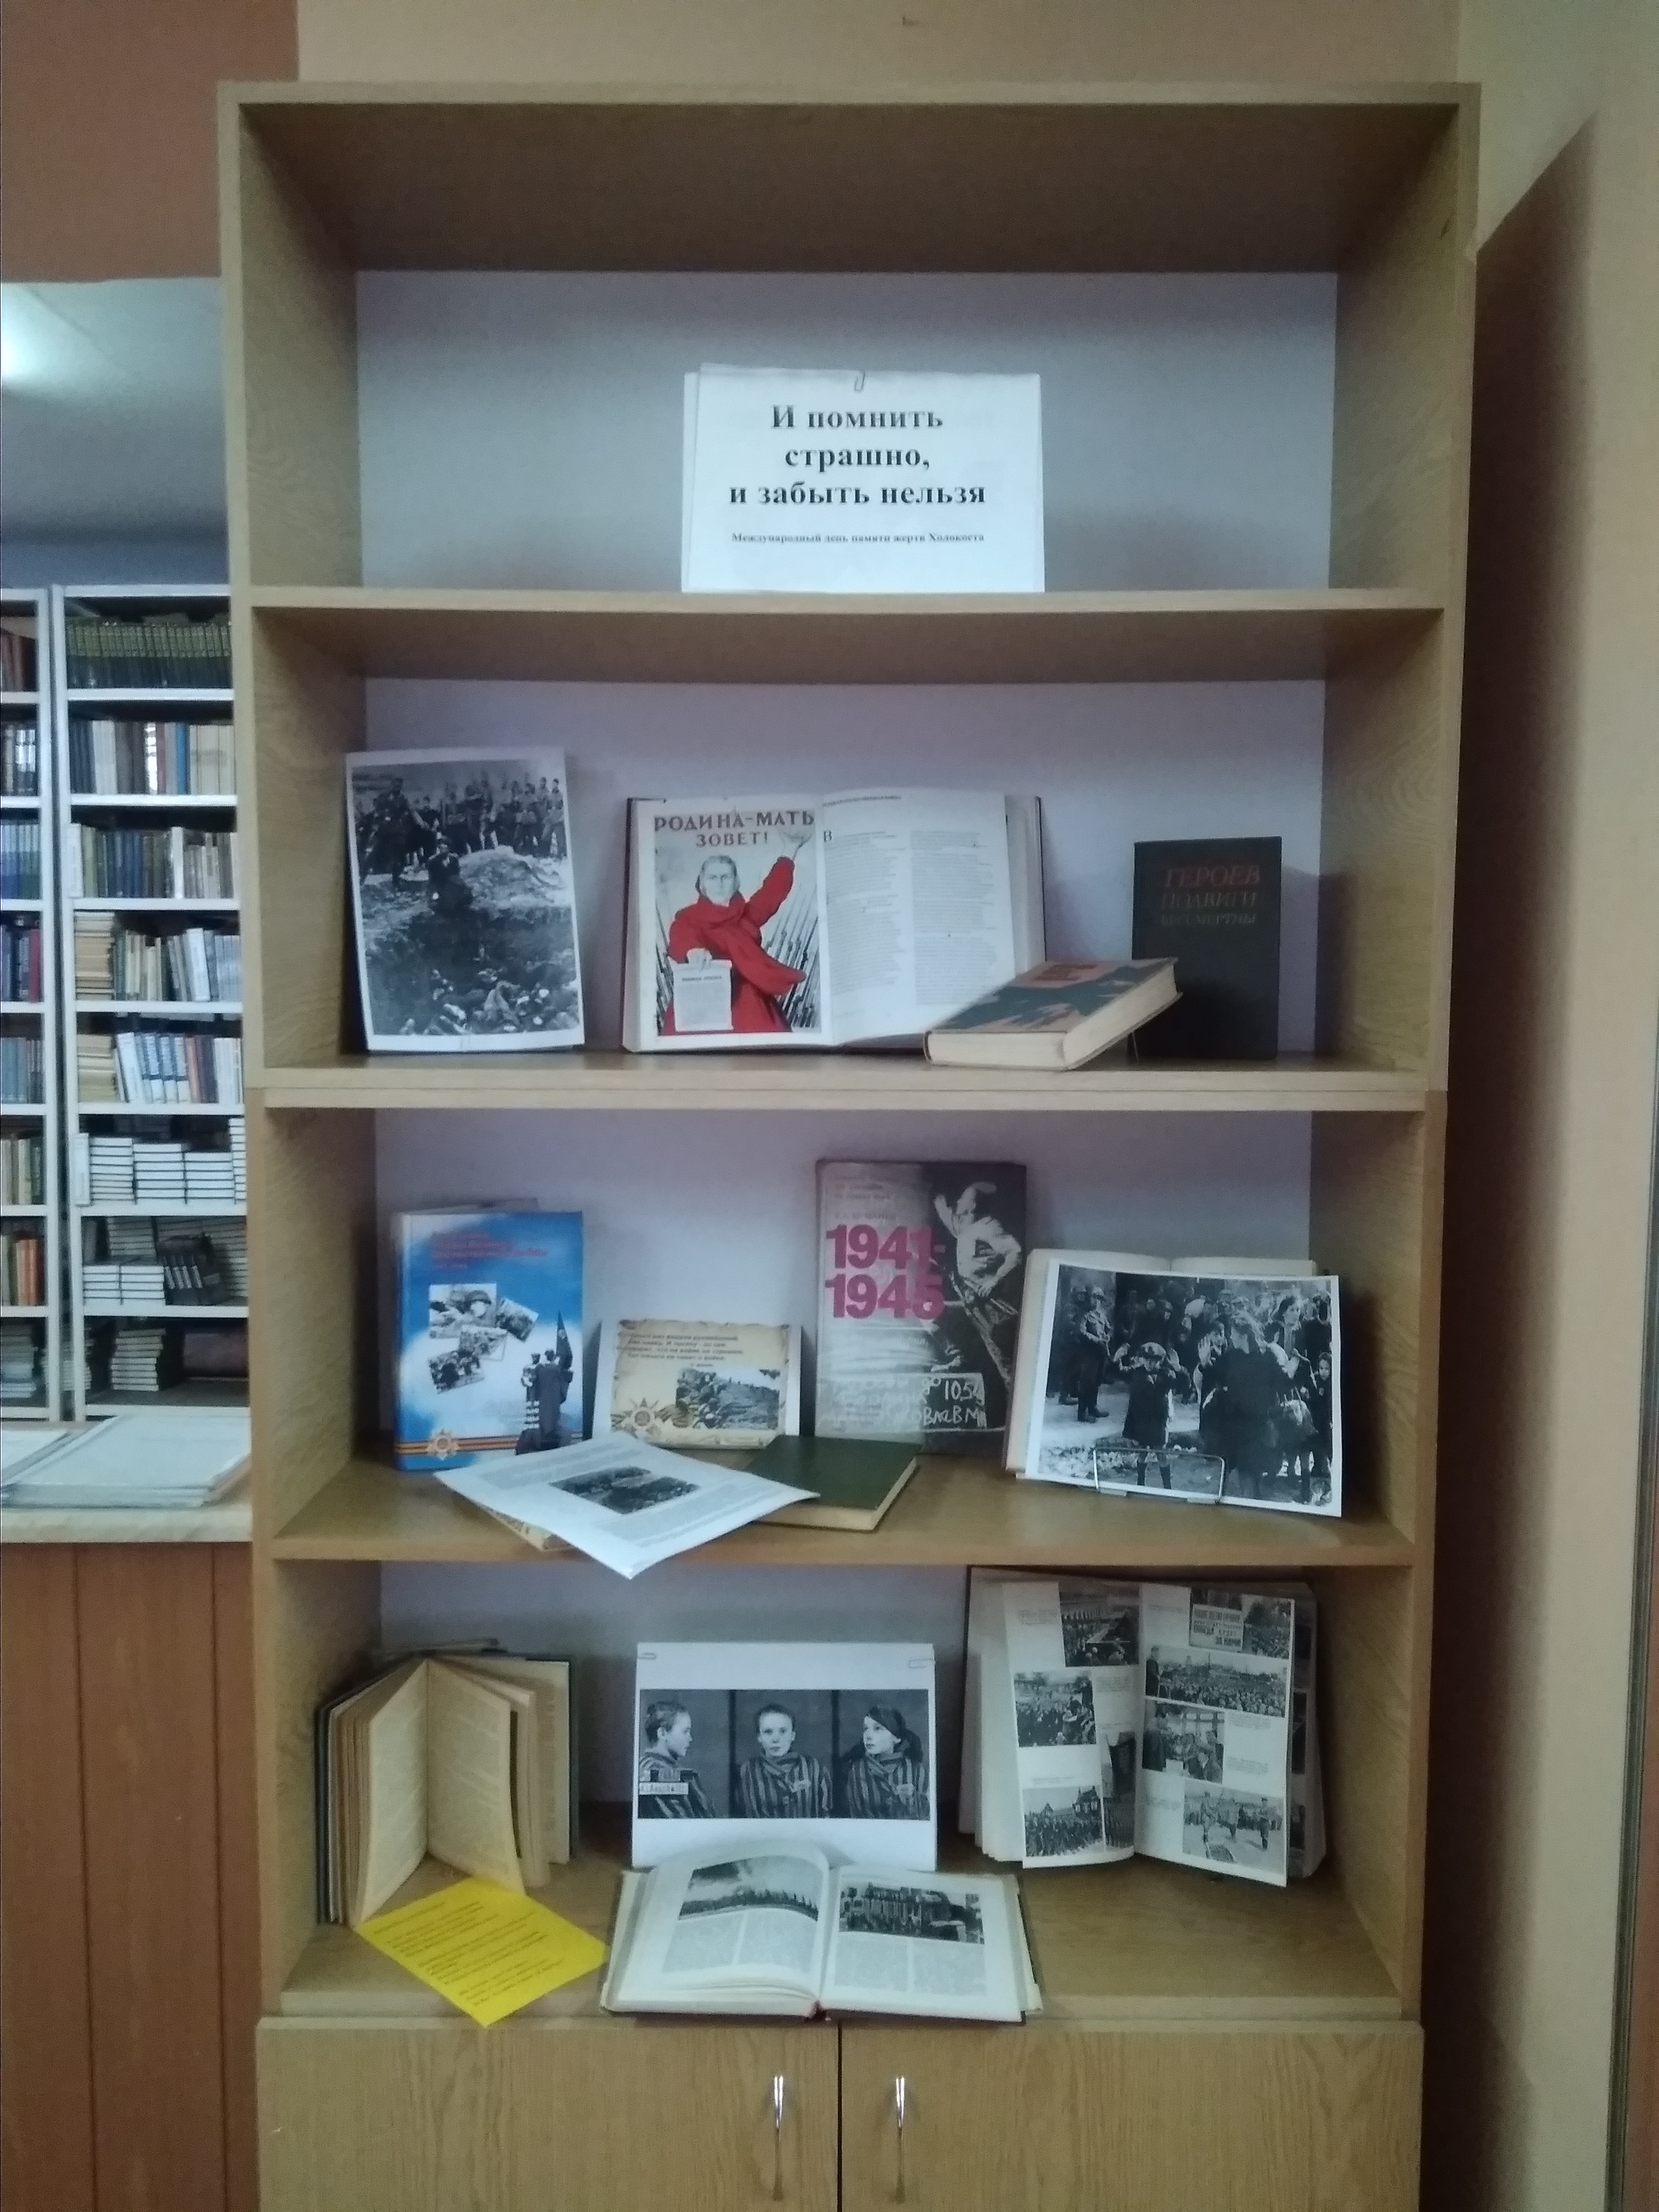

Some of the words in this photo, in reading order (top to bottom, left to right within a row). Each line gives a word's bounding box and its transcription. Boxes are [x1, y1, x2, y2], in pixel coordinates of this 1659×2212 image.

[773, 405, 794, 428] И
[808, 411, 943, 428] помнить
[785, 449, 929, 472] страшно,
[730, 487, 747, 504] и
[758, 481, 869, 504] забыть
[881, 487, 985, 504] нельзя
[732, 533, 820, 544] Международный
[824, 534, 848, 543] день
[893, 535, 925, 544] жертв
[929, 533, 984, 543] Холокоста
[654, 811, 815, 832] РОДИНА-МАТЬ
[696, 831, 768, 847] ЗОВЕТ!
[826, 1224, 932, 1269] 1941
[825, 1274, 945, 1320] 1945
